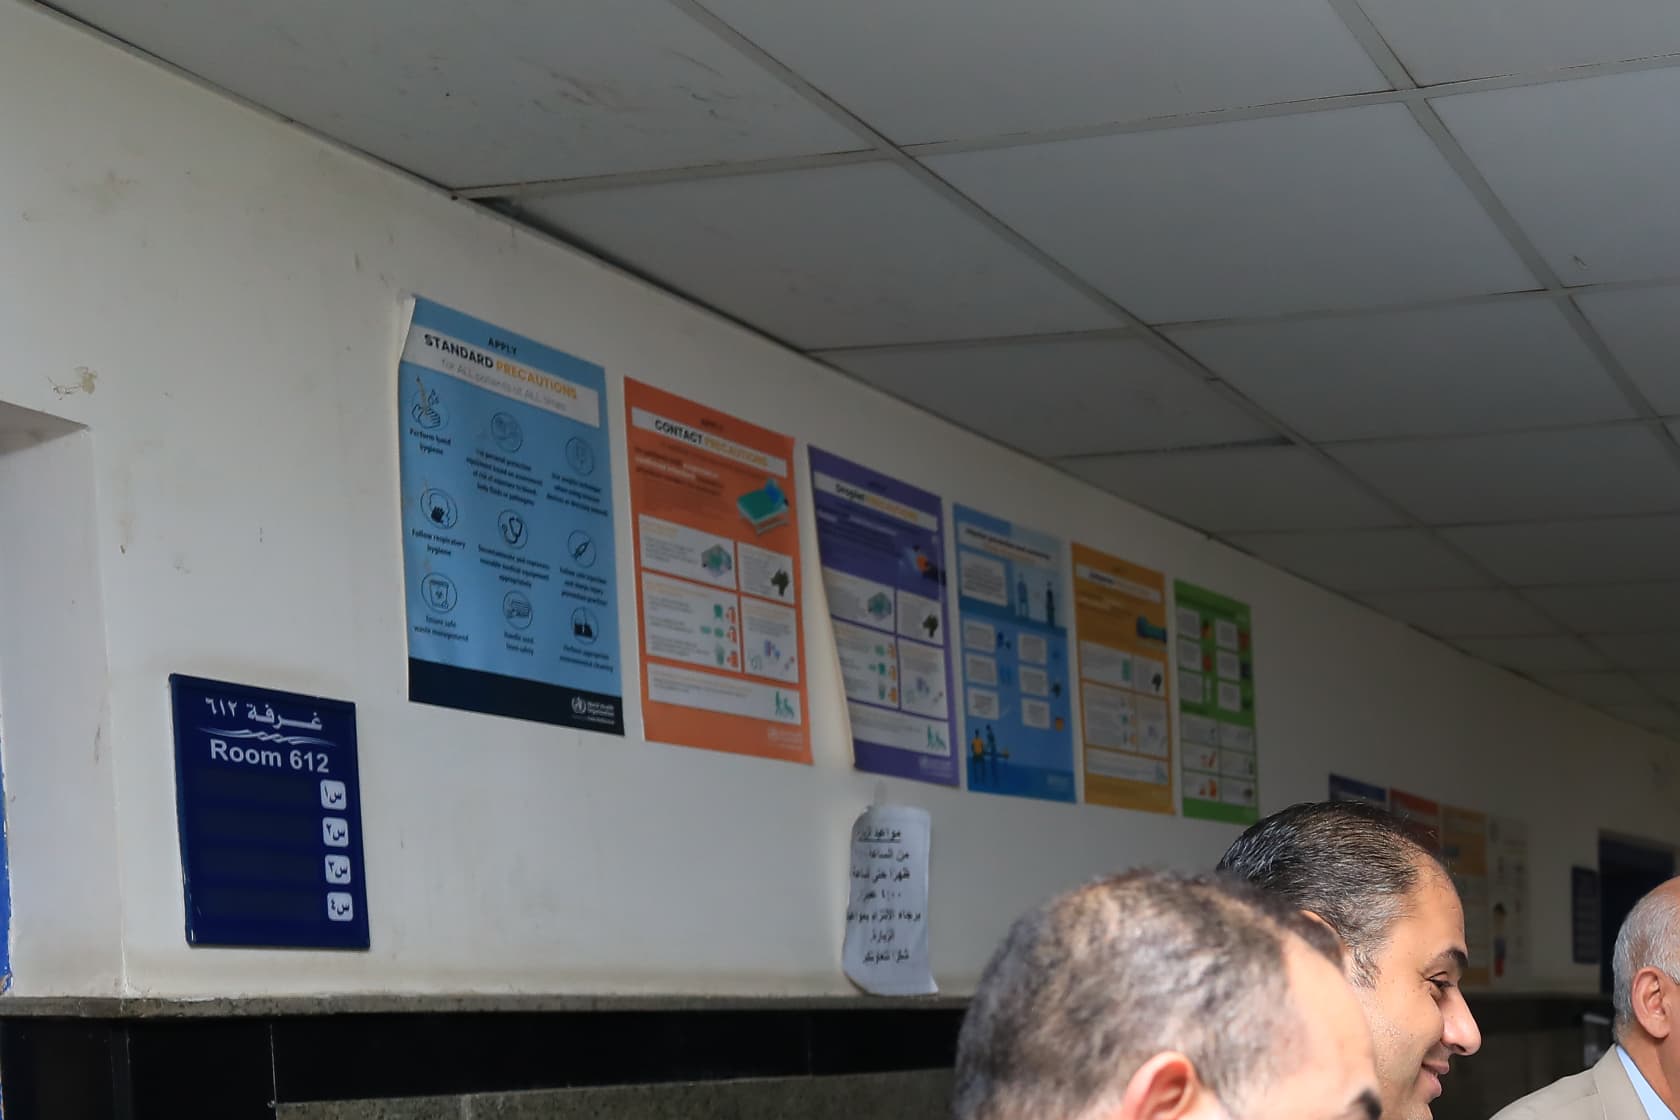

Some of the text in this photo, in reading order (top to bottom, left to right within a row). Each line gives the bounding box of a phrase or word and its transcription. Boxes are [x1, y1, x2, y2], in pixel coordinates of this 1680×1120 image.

[488, 337, 517, 355] APPLY
[424, 334, 577, 399] STANDARD PRECAUTIONS
[654, 419, 703, 445] CONTACT
[205, 697, 238, 717] ٦١٢
[210, 738, 330, 773] Room 612
